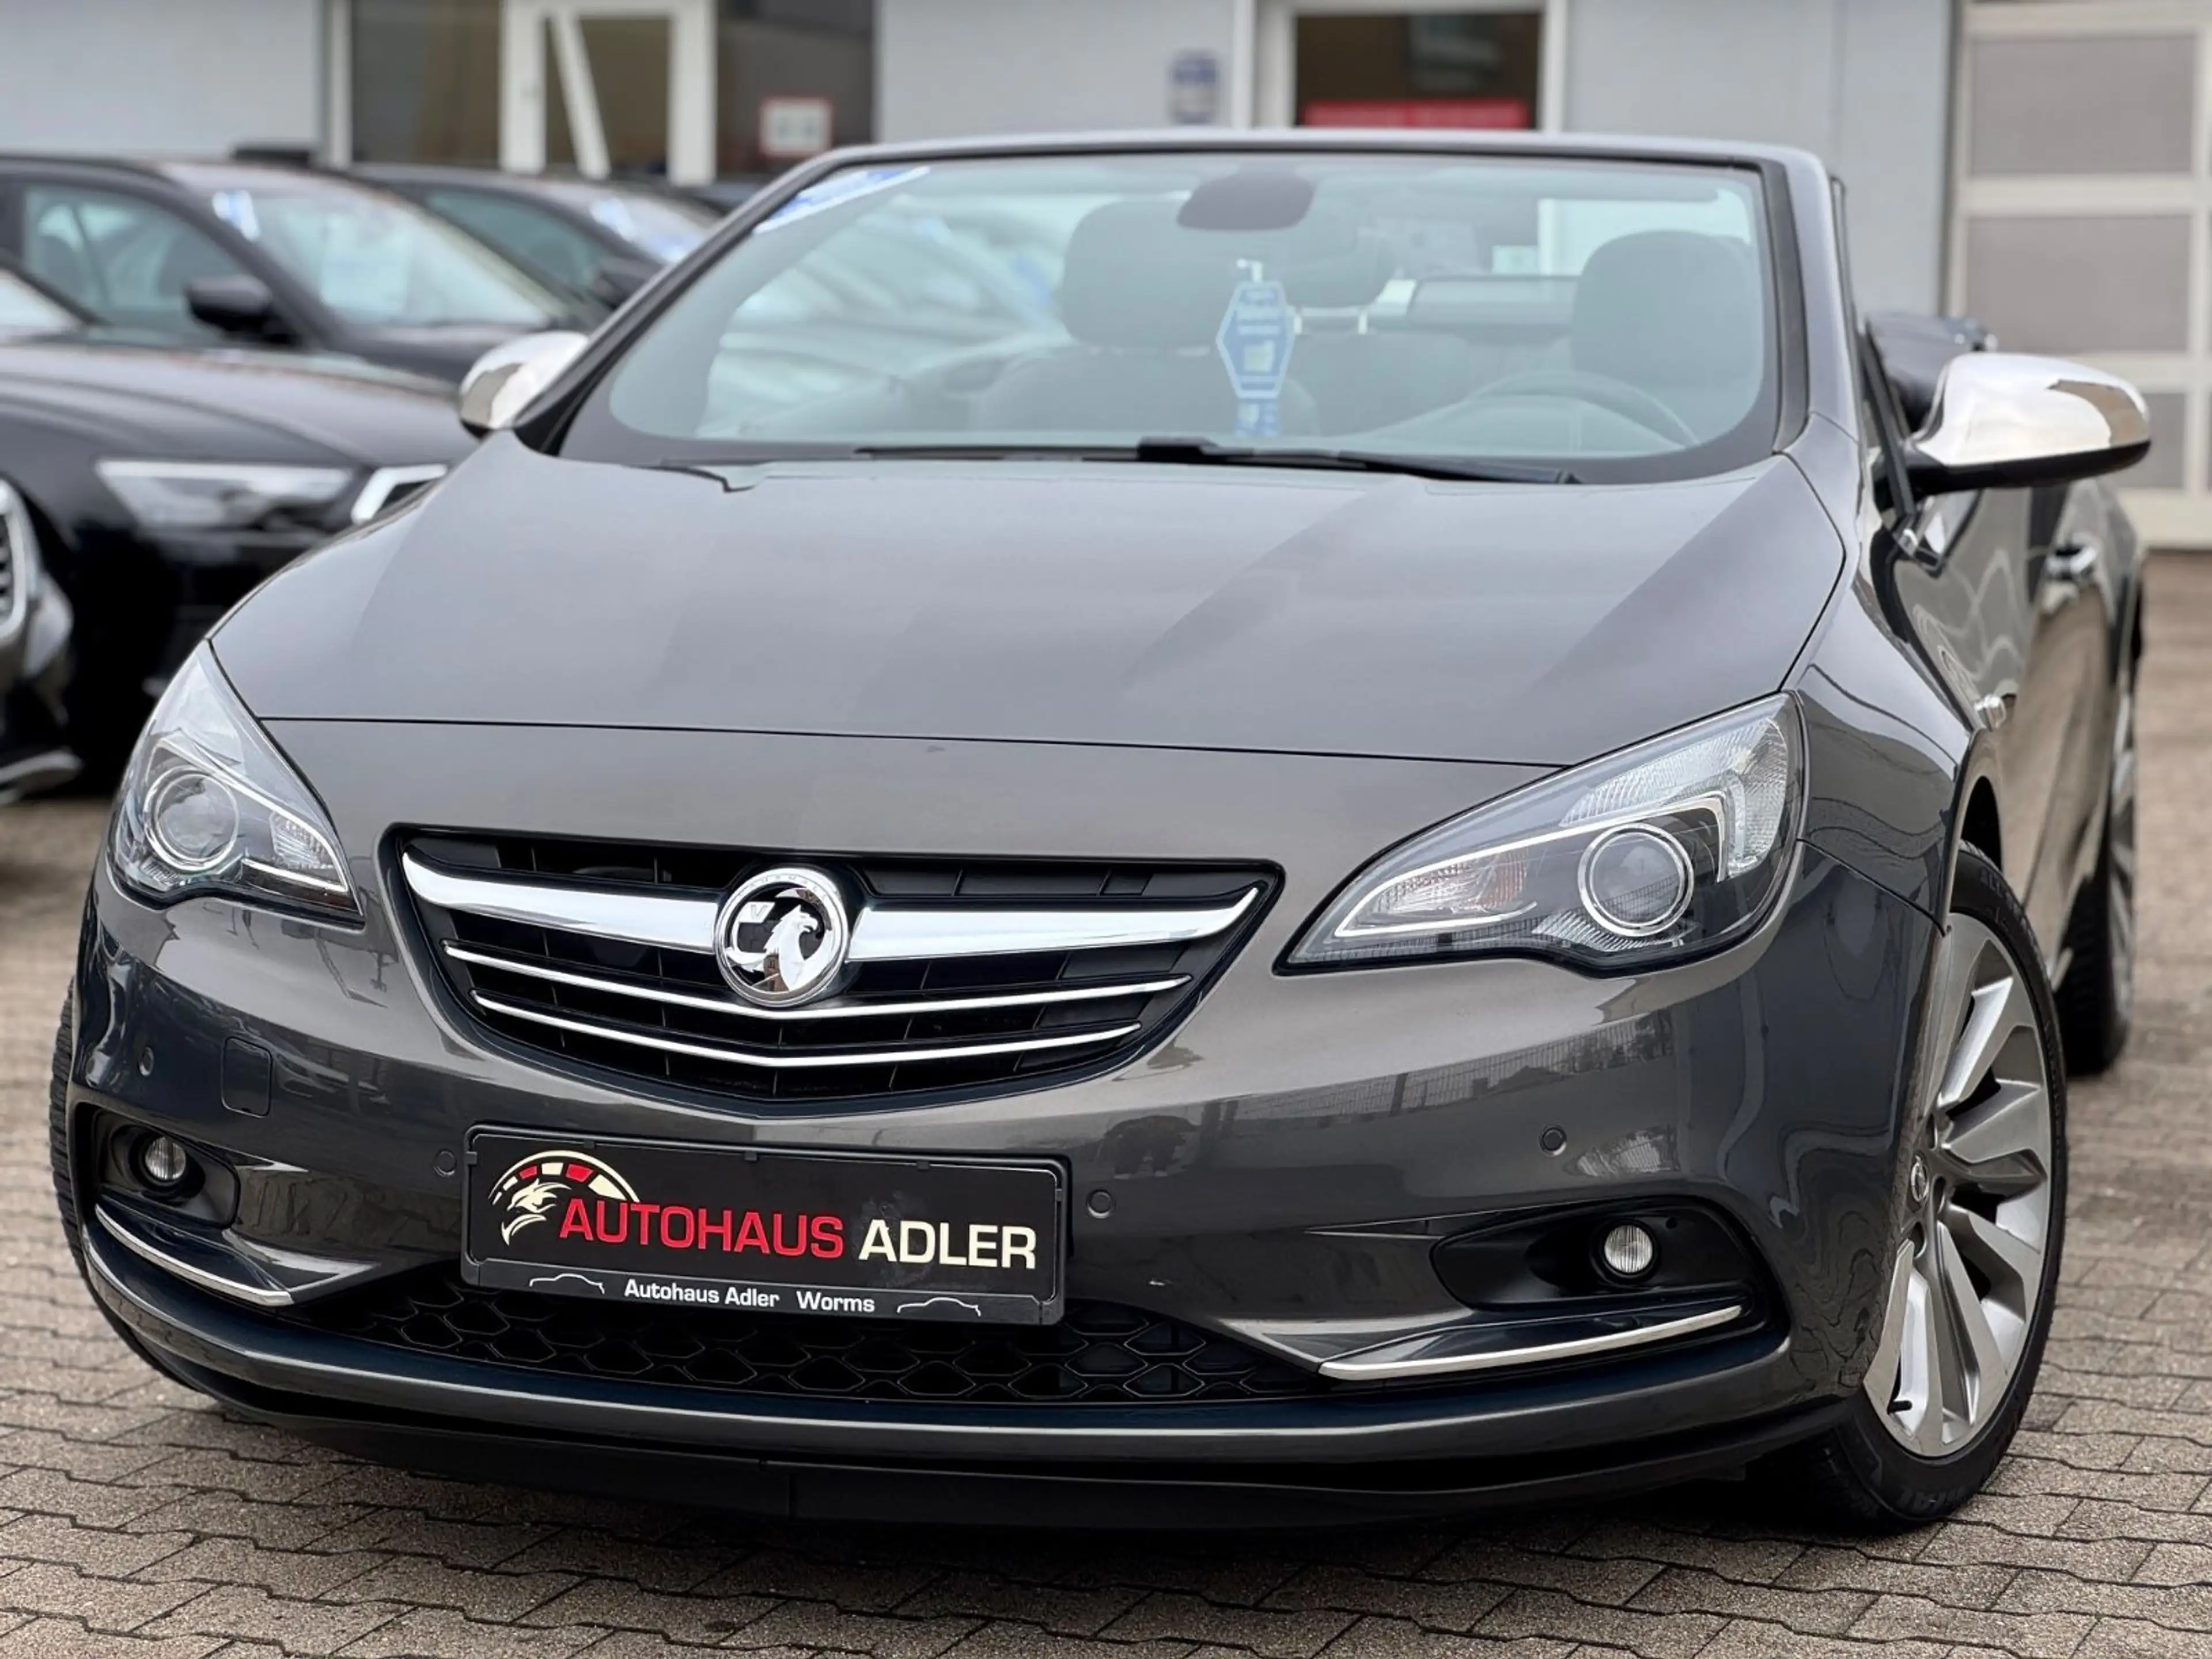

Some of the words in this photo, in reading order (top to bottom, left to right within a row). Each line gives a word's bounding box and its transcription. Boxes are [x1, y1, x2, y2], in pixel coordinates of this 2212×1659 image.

[559, 1198, 844, 1259] AUTOHAUS
[858, 1218, 1037, 1270] ADLER
[624, 1278, 720, 1304] Autohaus
[724, 1286, 780, 1308] Adler
[796, 1290, 876, 1313] Worms
